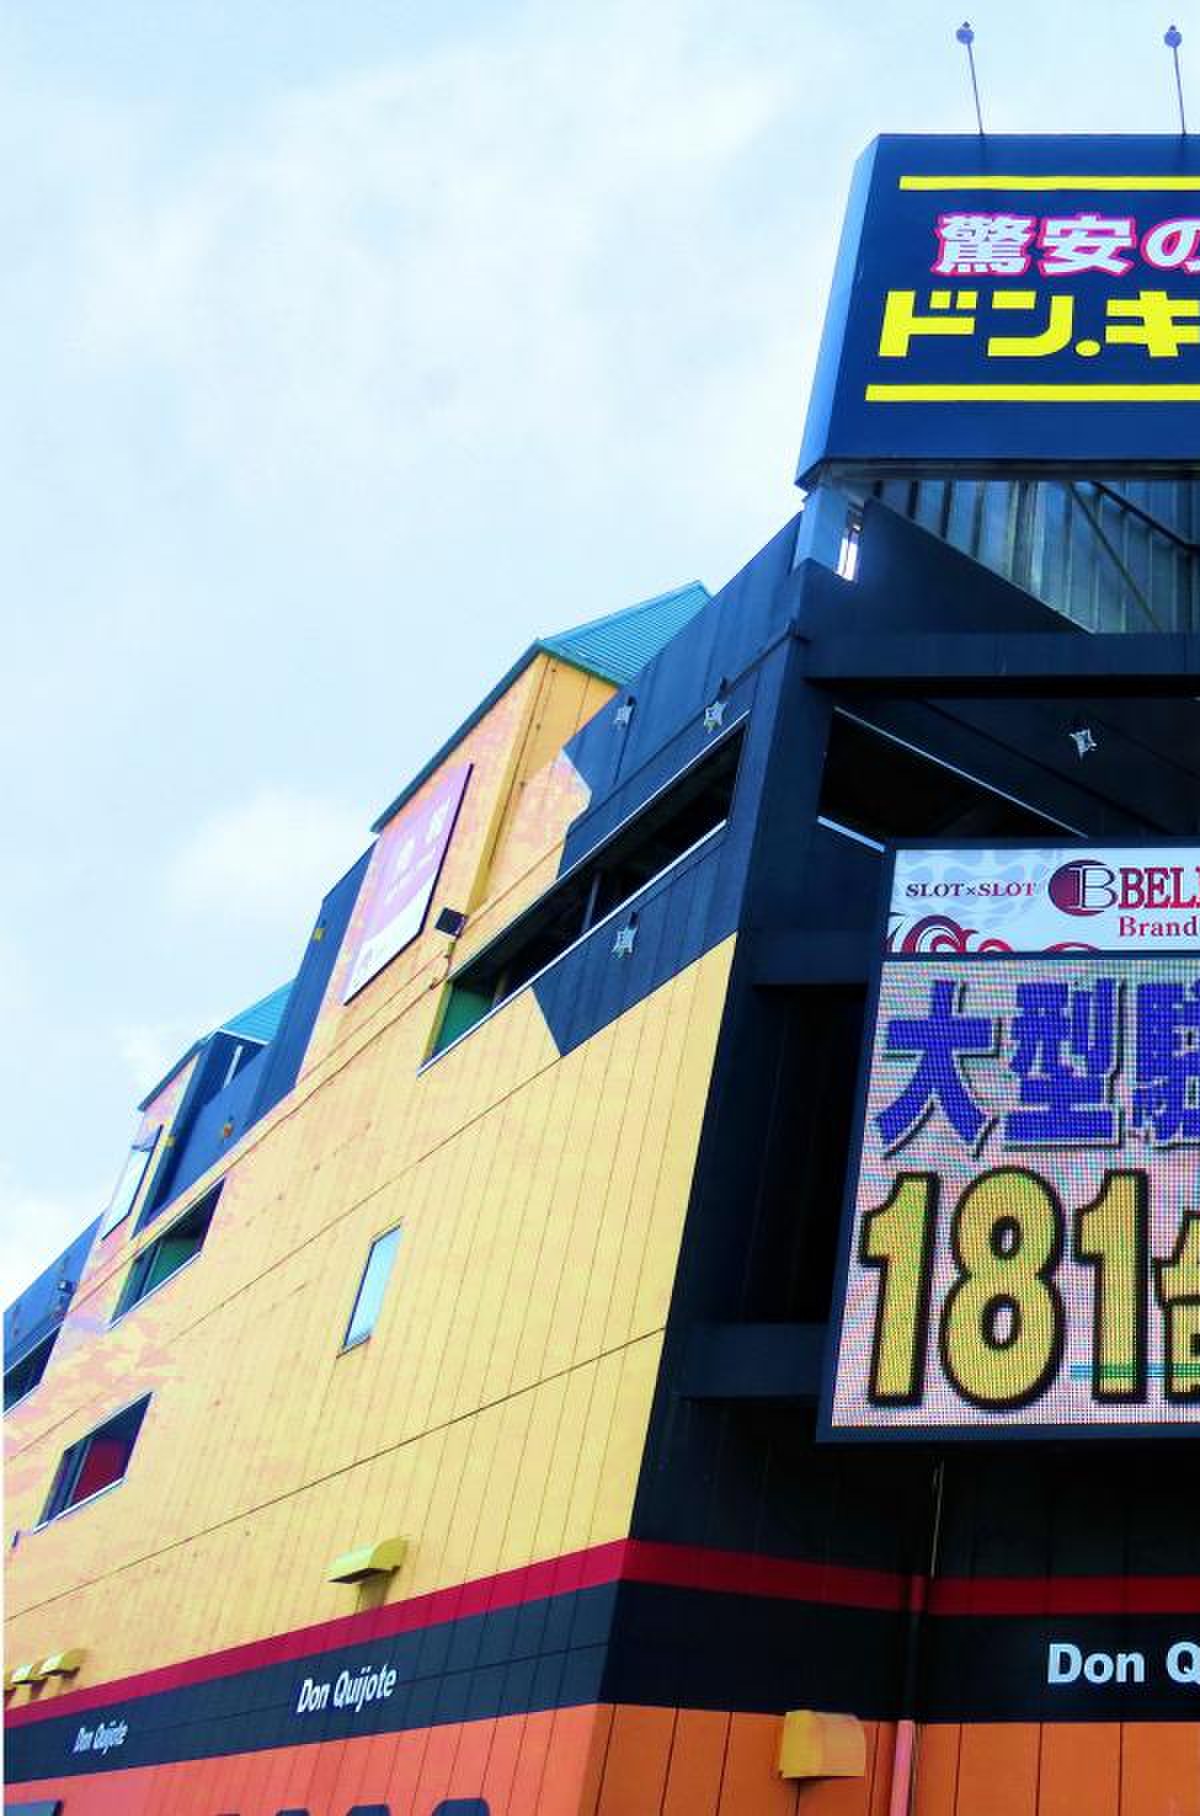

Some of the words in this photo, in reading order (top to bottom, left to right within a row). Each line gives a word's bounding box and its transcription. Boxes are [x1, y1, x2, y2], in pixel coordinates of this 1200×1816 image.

[1119, 915, 1198, 937] Brand
[1047, 1643, 1146, 1683] Don
[297, 1677, 331, 1713] Don
[333, 1664, 397, 1713] Quijote
[72, 1727, 94, 1752] Don
